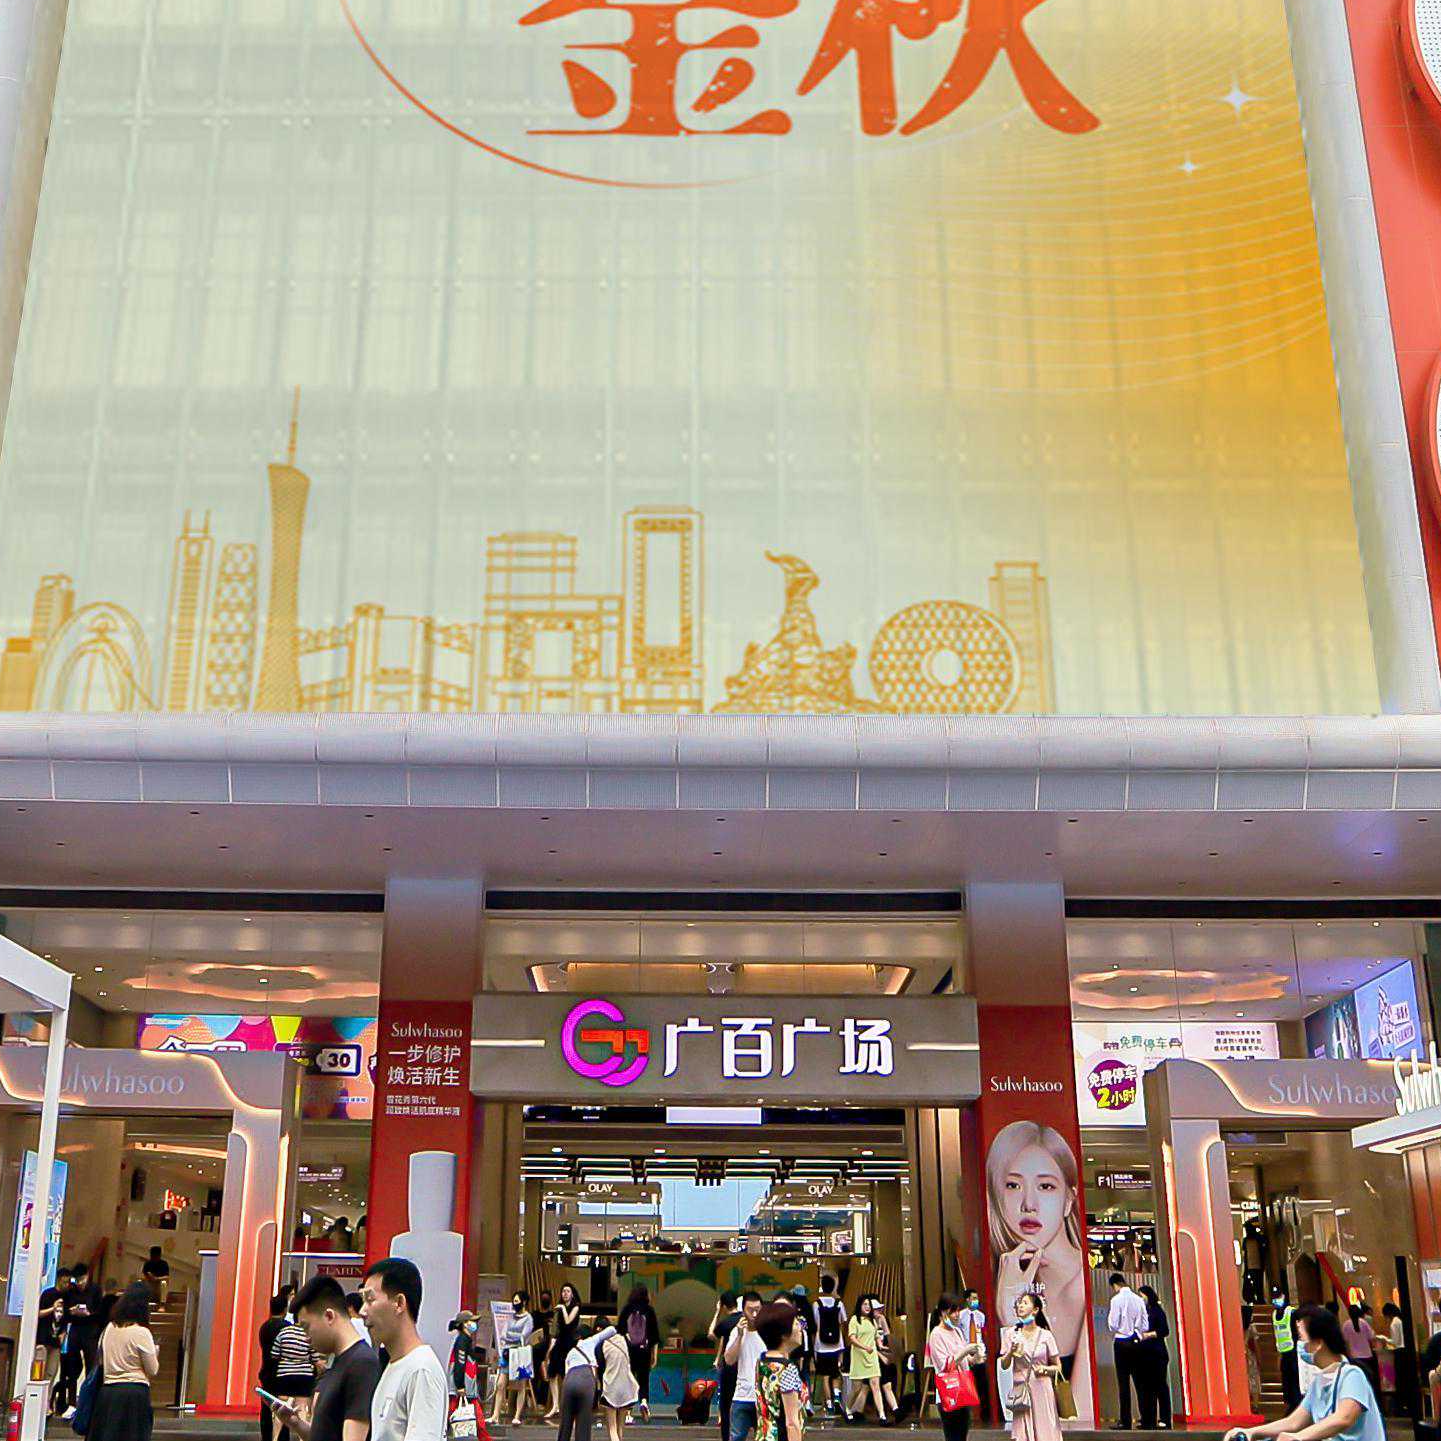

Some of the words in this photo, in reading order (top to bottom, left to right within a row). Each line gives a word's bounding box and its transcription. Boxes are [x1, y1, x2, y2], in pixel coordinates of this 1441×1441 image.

[391, 1022, 463, 1038] Sulwhasoo
[388, 1044, 461, 1064] 一步修护
[663, 1016, 895, 1078] 广百广场
[328, 1052, 351, 1068] 30
[38, 1061, 185, 1095] lwhasoo
[387, 1066, 460, 1086] 焕活新生
[990, 1075, 1063, 1092] Sulwhasoo
[1088, 1065, 1137, 1088] 免费停车
[1096, 1086, 1136, 1109] 2小时
[1268, 1072, 1397, 1105] Sulwhaso
[588, 1183, 614, 1194] OLAY
[808, 1185, 834, 1196] OLAY
[1097, 1176, 1111, 1187] F1
